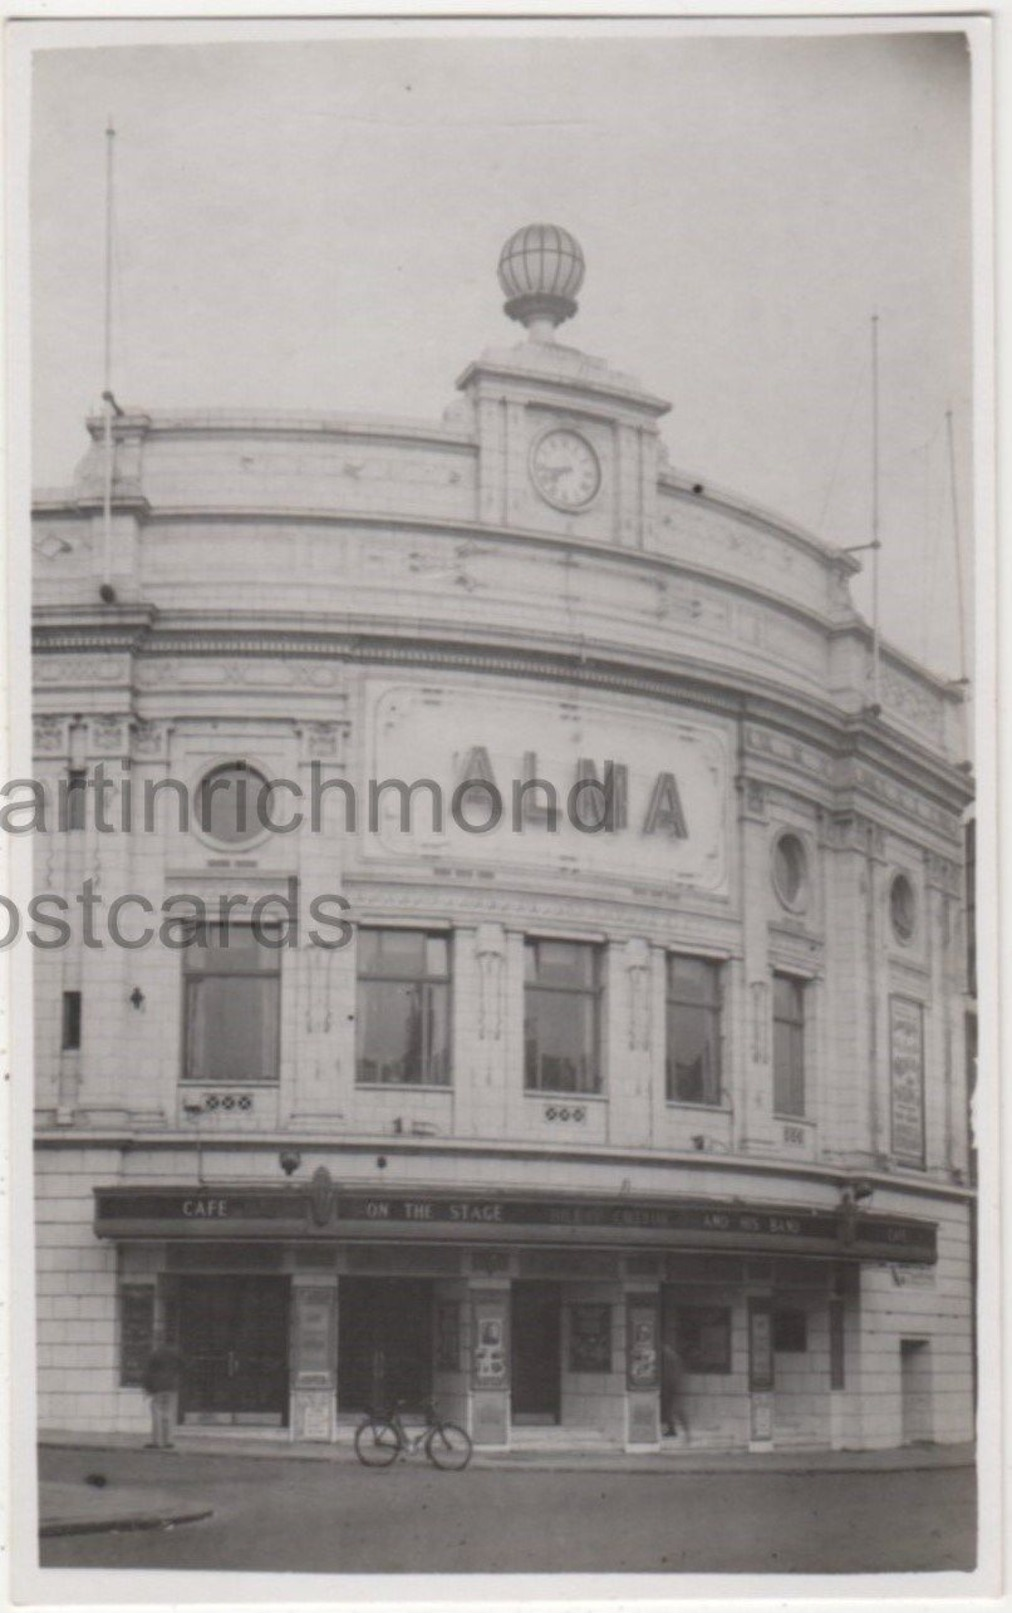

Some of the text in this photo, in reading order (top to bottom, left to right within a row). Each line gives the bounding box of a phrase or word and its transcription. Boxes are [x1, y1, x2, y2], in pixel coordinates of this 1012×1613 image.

[453, 746, 690, 839] ALMA
[182, 1200, 227, 1217] CAFE
[366, 1202, 502, 1221] ON THE STAGE
[703, 1214, 730, 1229] AND
